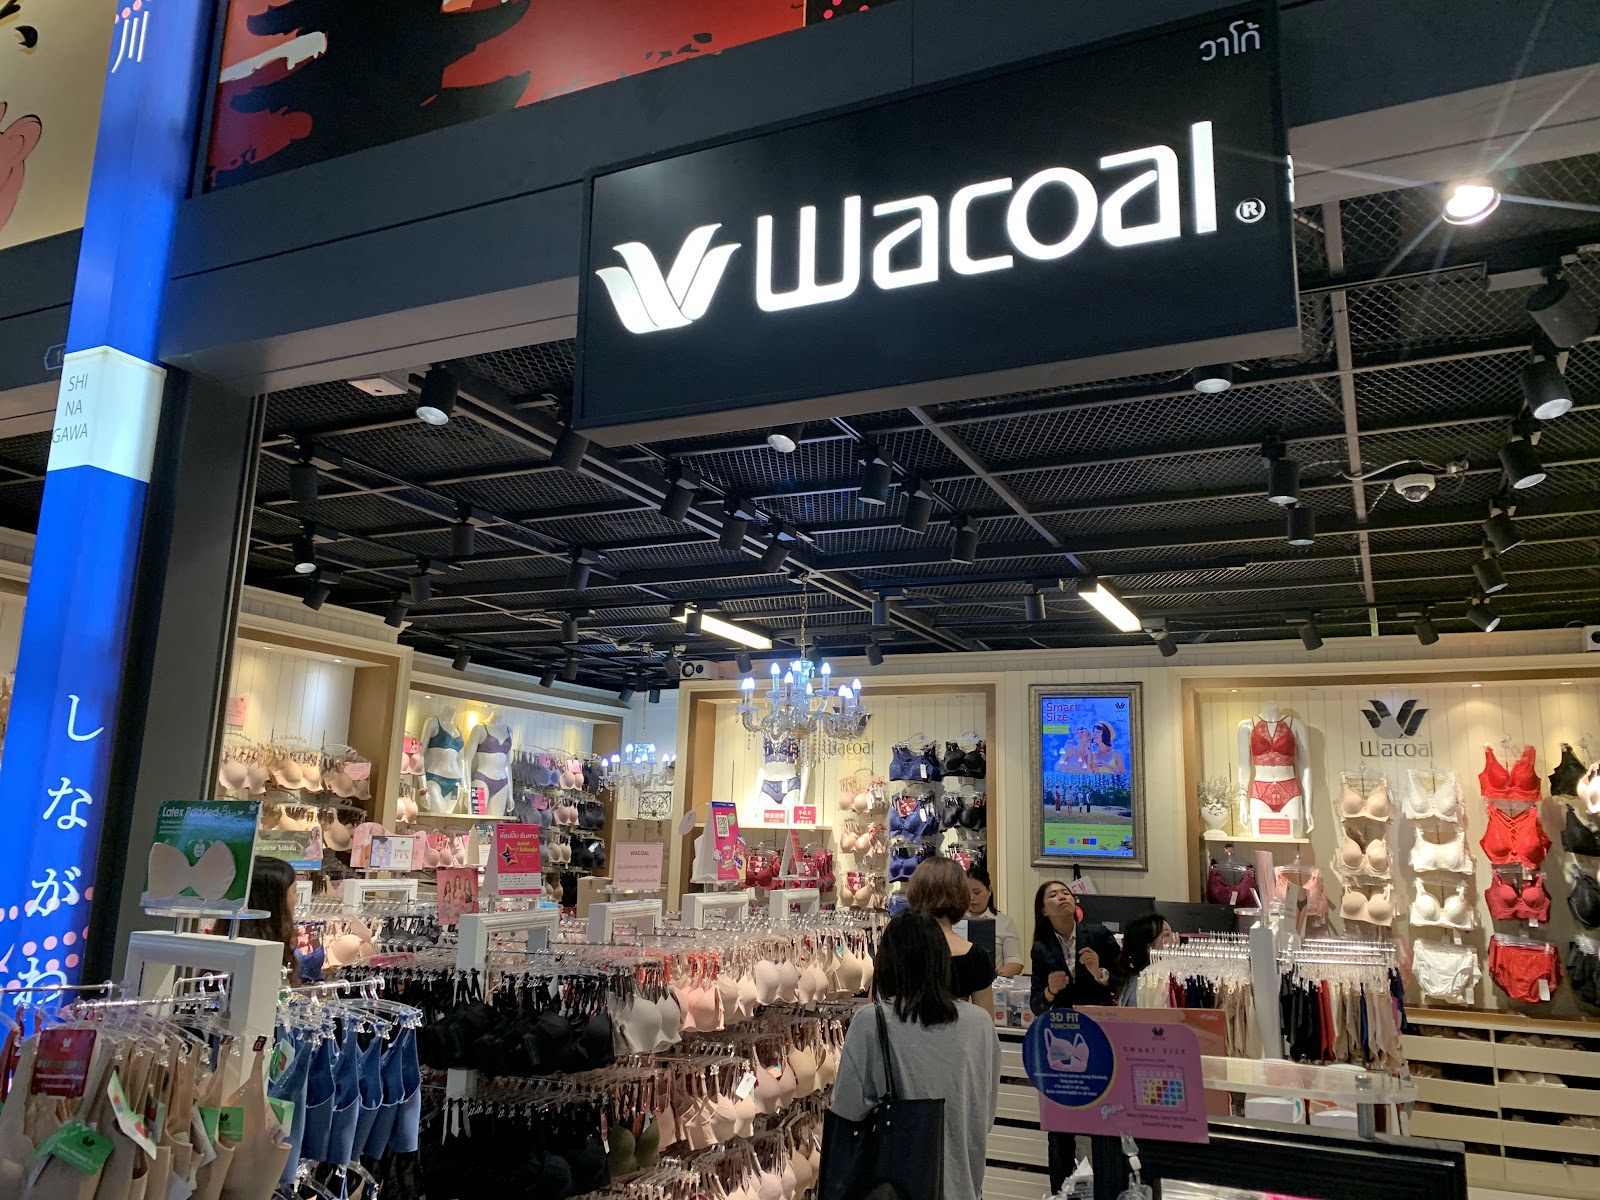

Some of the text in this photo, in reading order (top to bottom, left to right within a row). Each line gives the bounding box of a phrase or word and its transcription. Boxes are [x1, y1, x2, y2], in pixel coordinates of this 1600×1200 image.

[111, 11, 149, 74] 川
[1199, 19, 1261, 61] วาโก้
[67, 373, 89, 392] SHI
[64, 399, 83, 417] NA
[52, 422, 89, 444] GAWA
[1046, 702, 1079, 712] Smart
[1046, 712, 1069, 722] Size
[162, 806, 184, 817] Latex
[184, 806, 220, 818] Padded
[1049, 1012, 1064, 1022] 3D
[1066, 1013, 1080, 1022] FIT
[1163, 1047, 1186, 1055] SIZE
